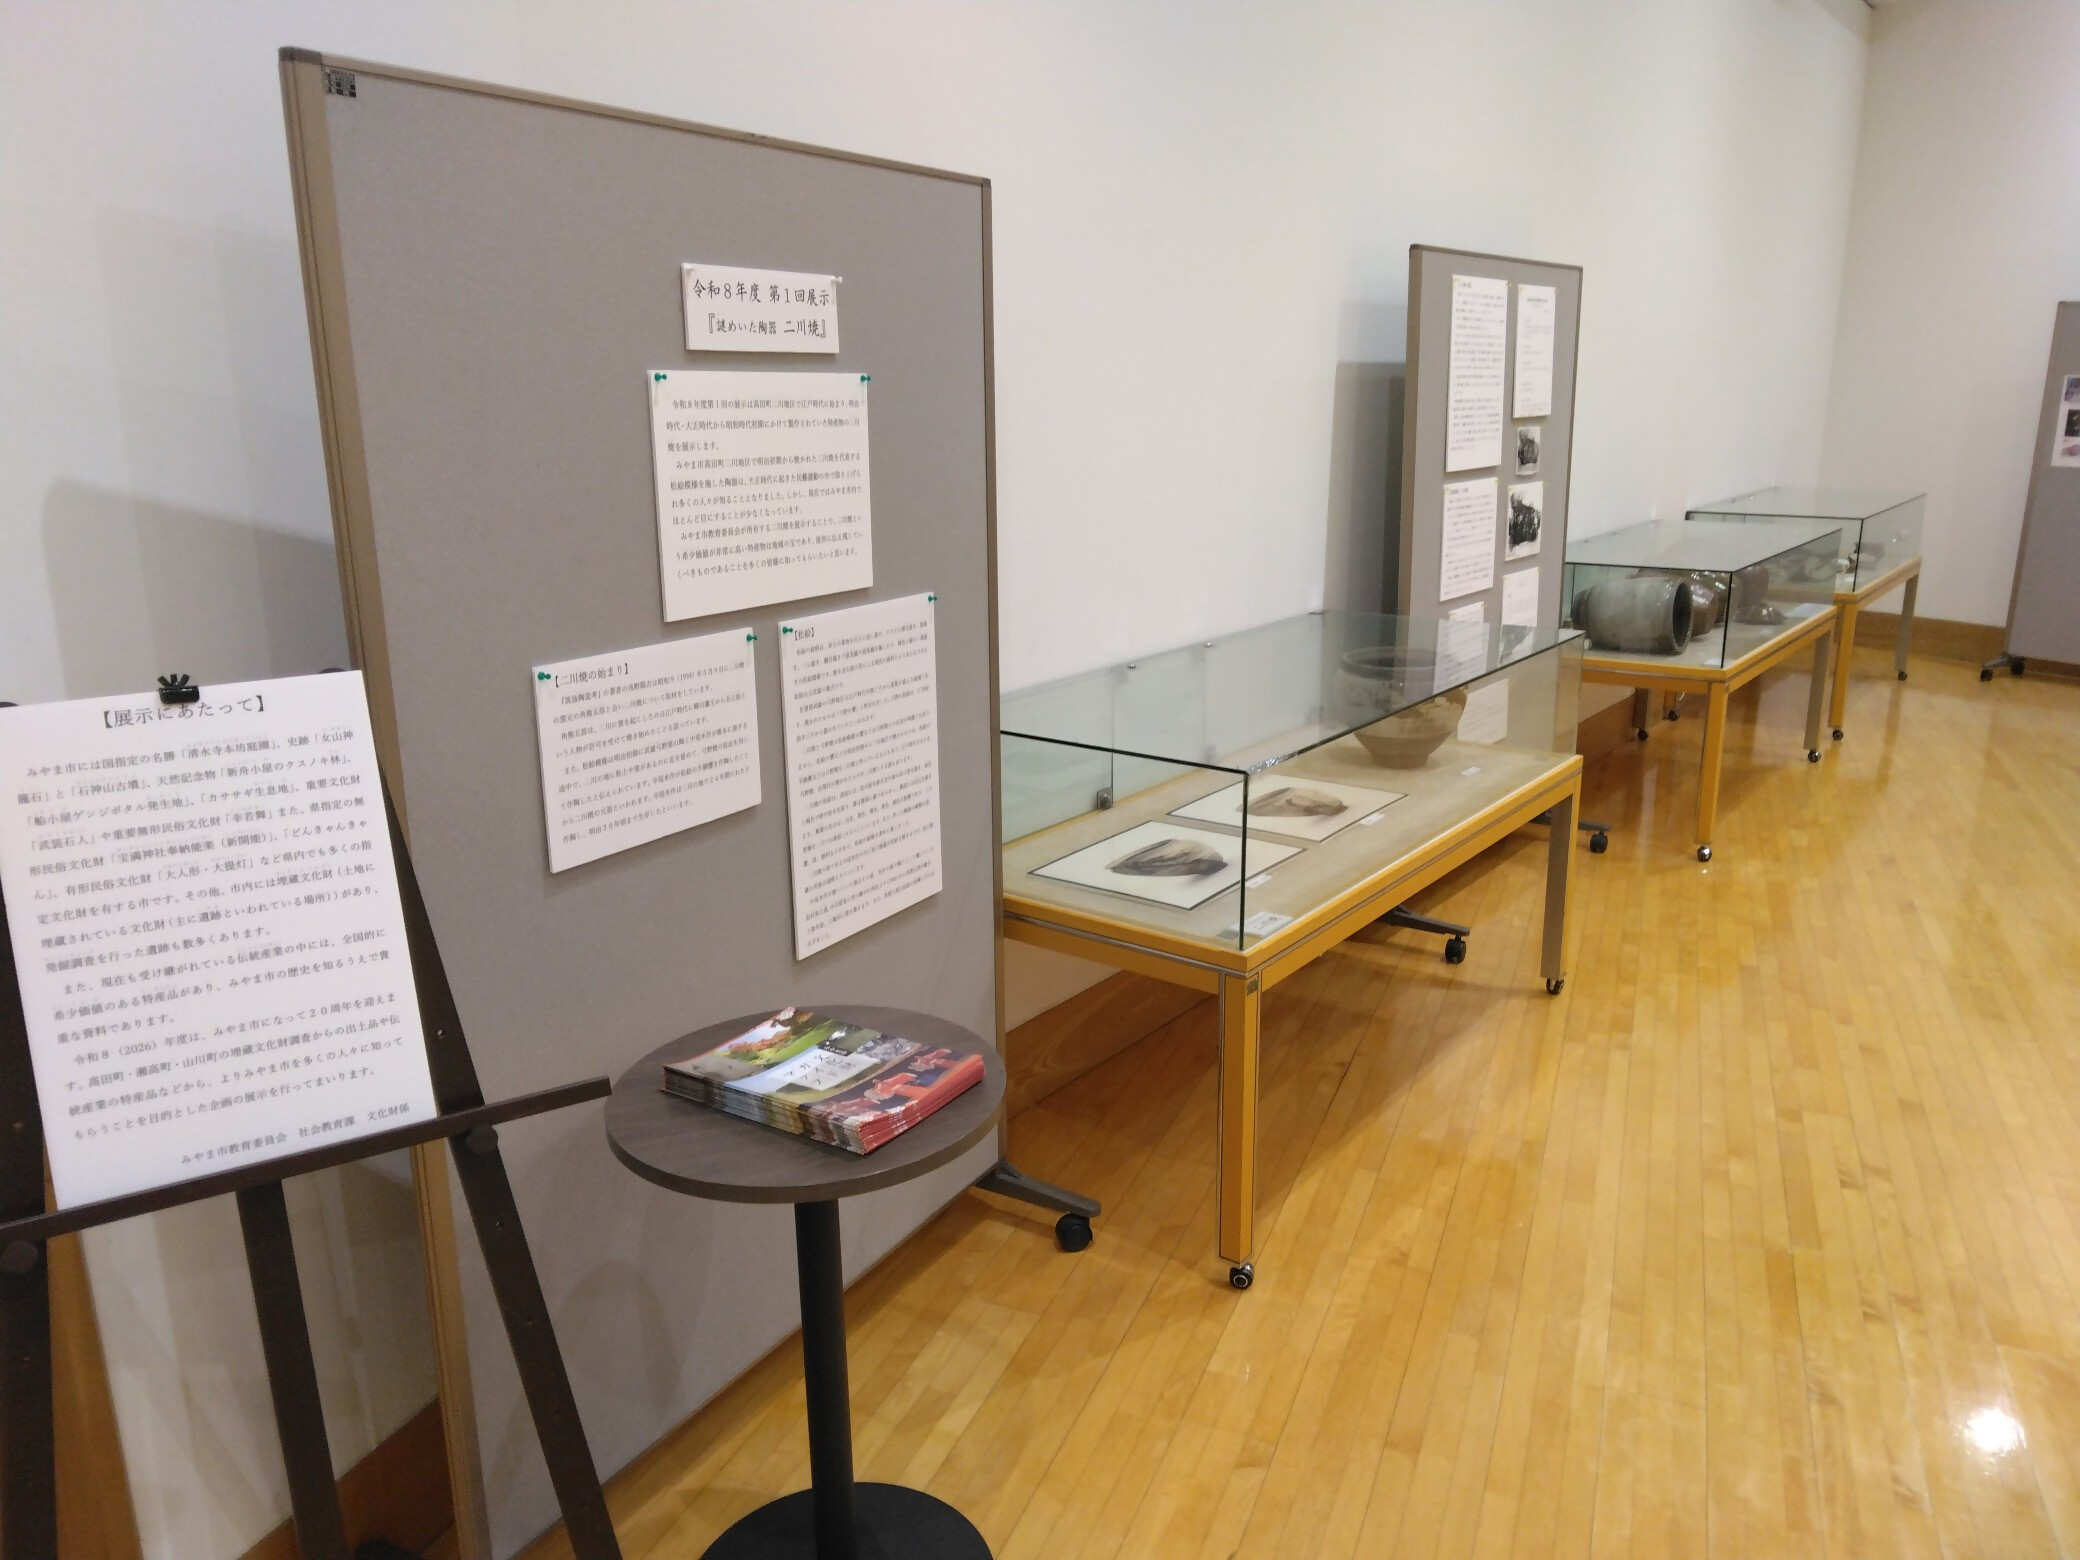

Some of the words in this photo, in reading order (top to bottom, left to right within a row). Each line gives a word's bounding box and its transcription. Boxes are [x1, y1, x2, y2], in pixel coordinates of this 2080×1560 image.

[692, 278, 762, 303] 令和8年度
[769, 284, 830, 307] 第1回展示
[708, 312, 777, 335] 『謎めいた陶器
[783, 318, 826, 339] 二川焼』
[667, 440, 719, 453] 焼を展示します。
[793, 626, 815, 642] 【松絵】
[554, 662, 629, 689] 【二川焼の始まり】
[103, 694, 265, 729] 【展示にあたって】
[46, 926, 270, 973] 発掘調査を行った遺跡も数多くあります。
[57, 1013, 174, 1044] 重な資料であります。
[74, 1066, 375, 1140] もらうことを目的とした企画の展示を行ってまいります。
[181, 1132, 287, 1164] みやま市教育委員会
[298, 1115, 355, 1138] 社会教育課
[369, 1102, 410, 1121] 文化財係
